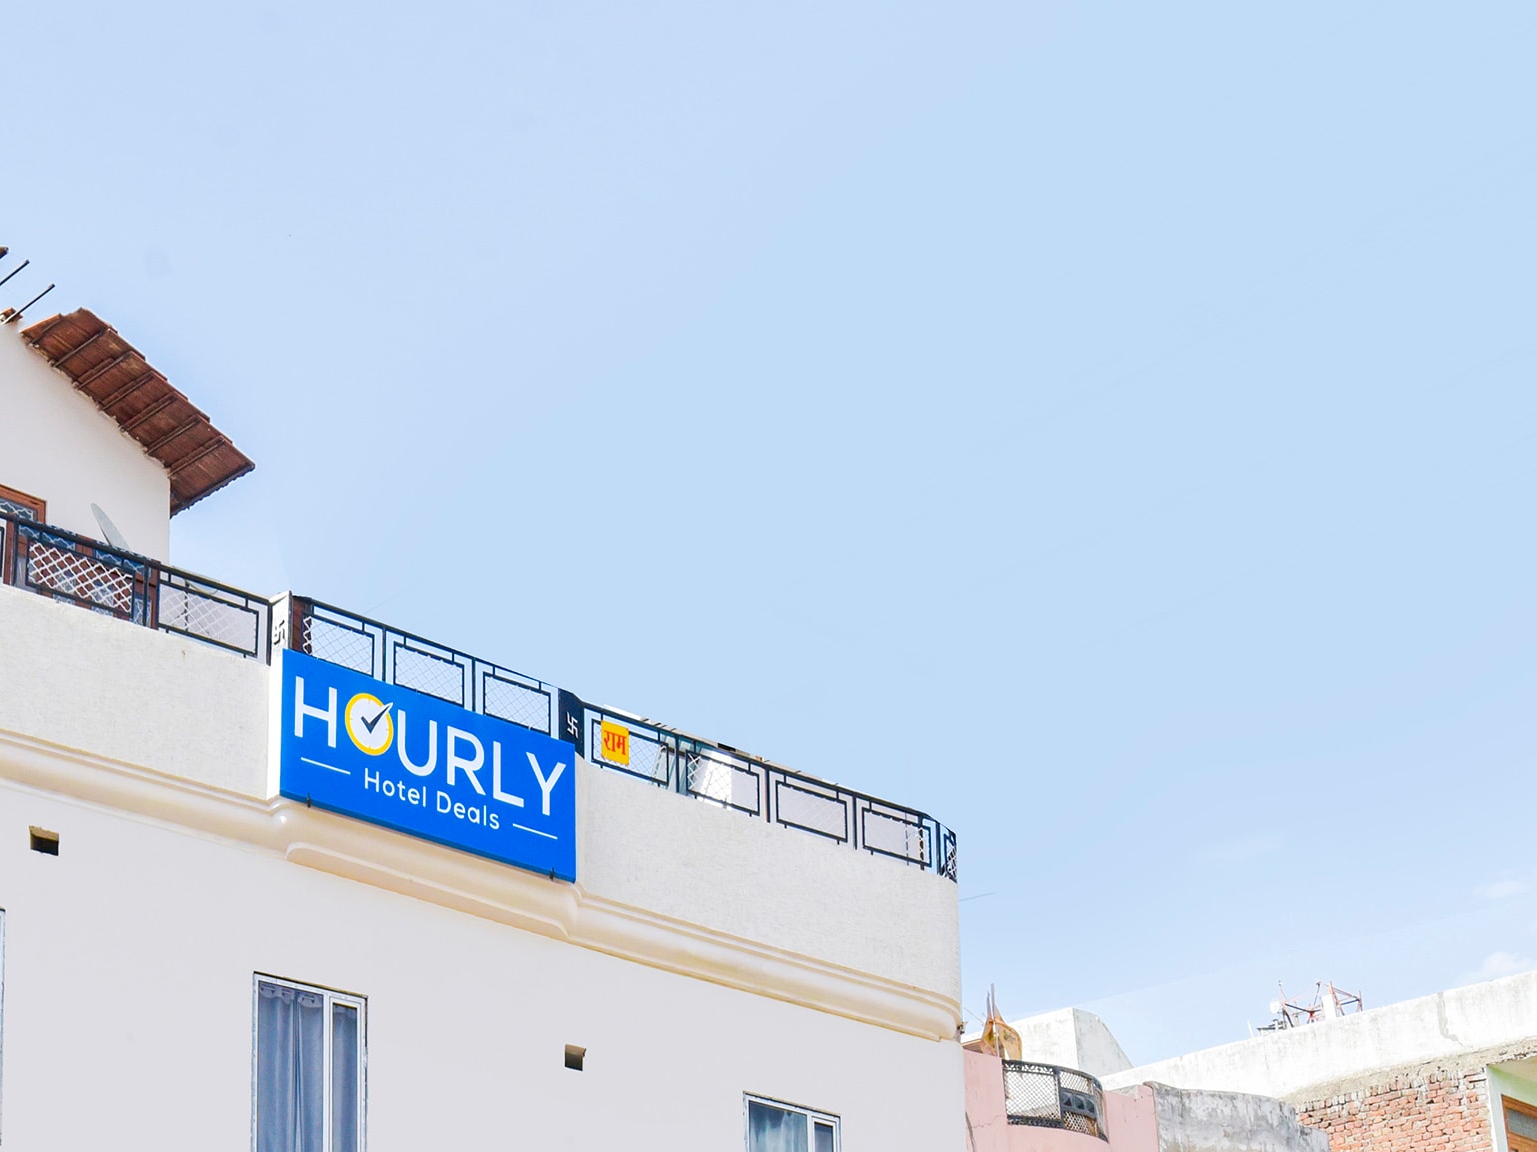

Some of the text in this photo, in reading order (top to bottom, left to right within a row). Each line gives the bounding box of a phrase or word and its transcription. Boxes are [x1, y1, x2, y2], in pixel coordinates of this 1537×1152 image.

[294, 675, 567, 817] HOURLY
[602, 727, 629, 757] राम
[363, 766, 501, 831] Hotel Deals
